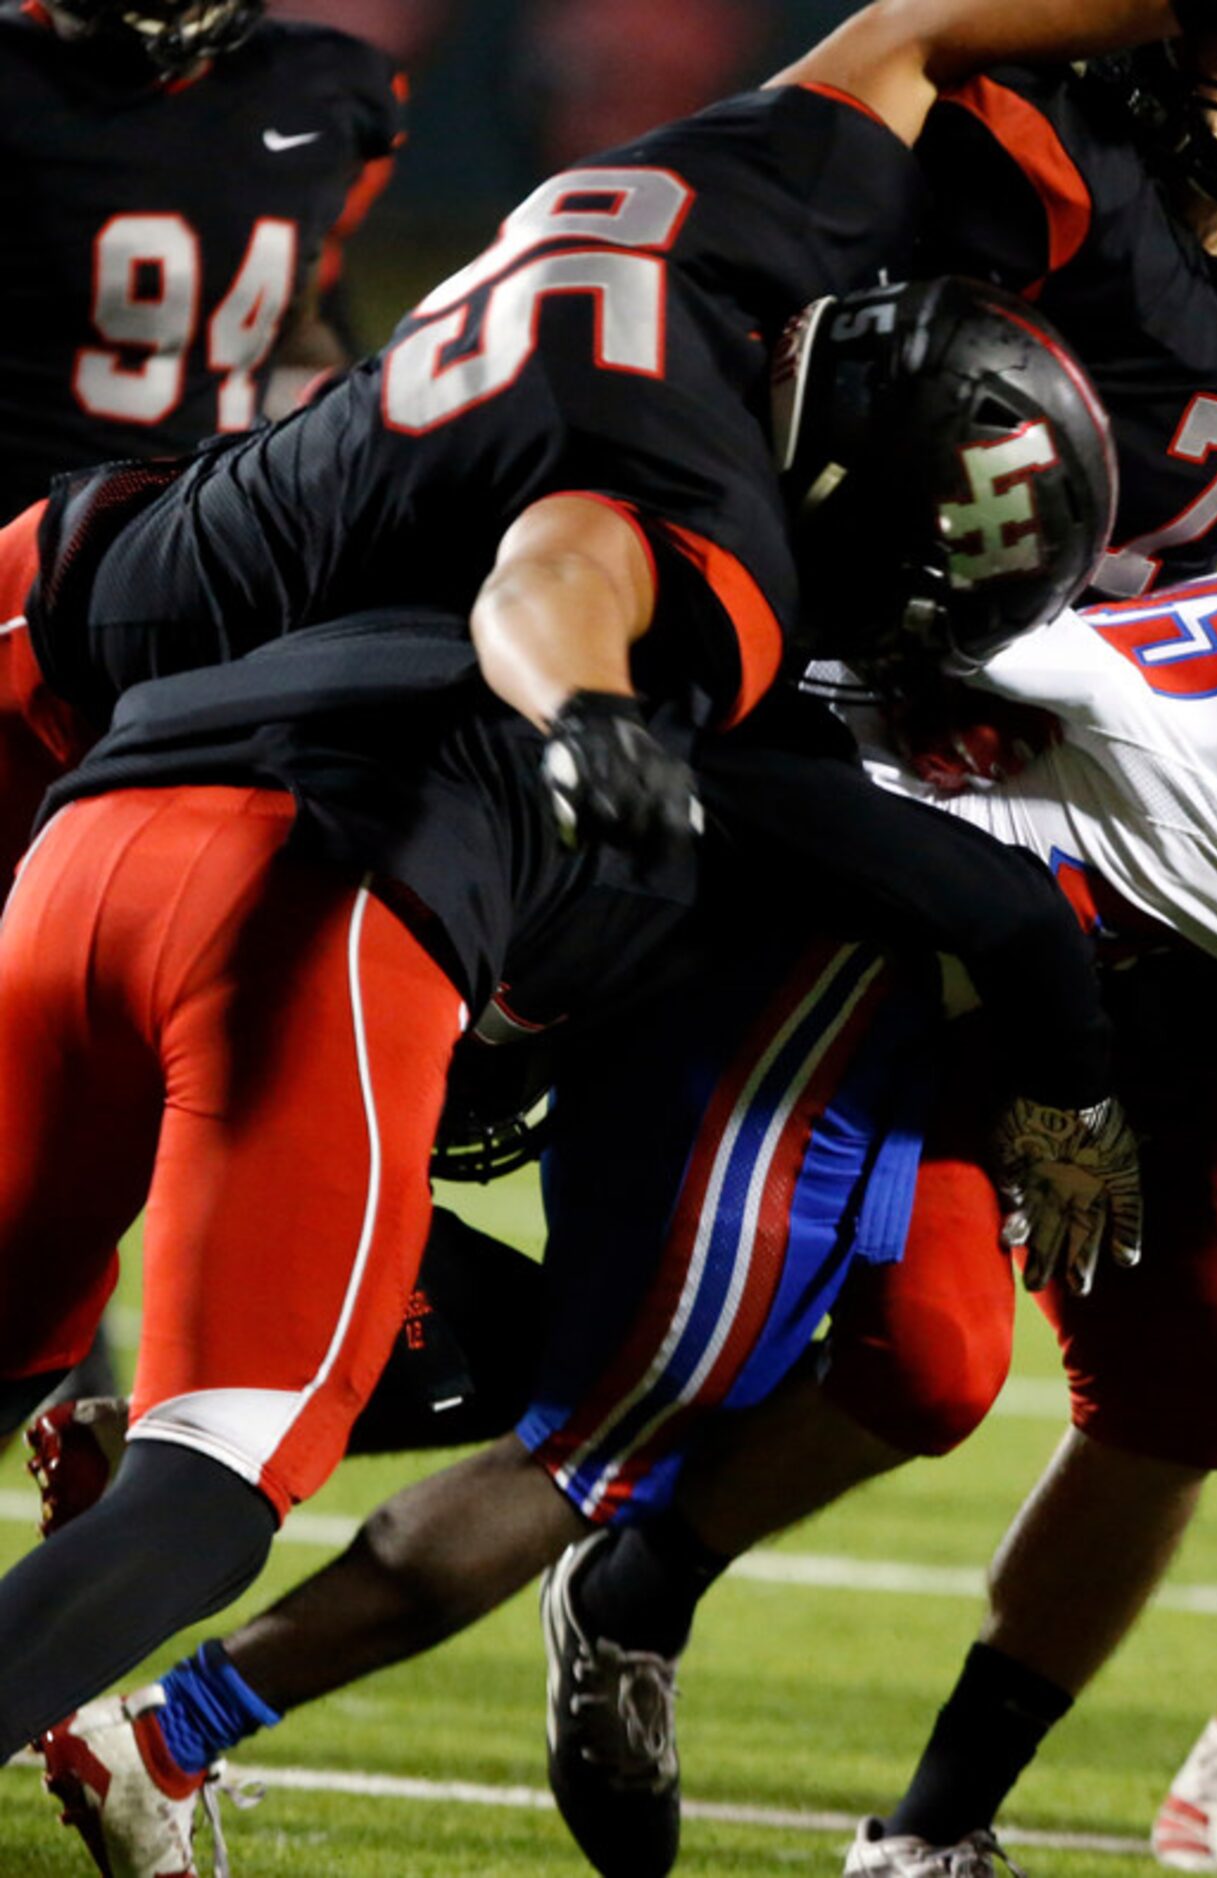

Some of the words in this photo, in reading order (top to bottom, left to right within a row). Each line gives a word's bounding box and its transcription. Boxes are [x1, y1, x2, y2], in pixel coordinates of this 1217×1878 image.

[74, 211, 298, 432] 94
[381, 166, 695, 436] 95
[941, 417, 1060, 591] LH
